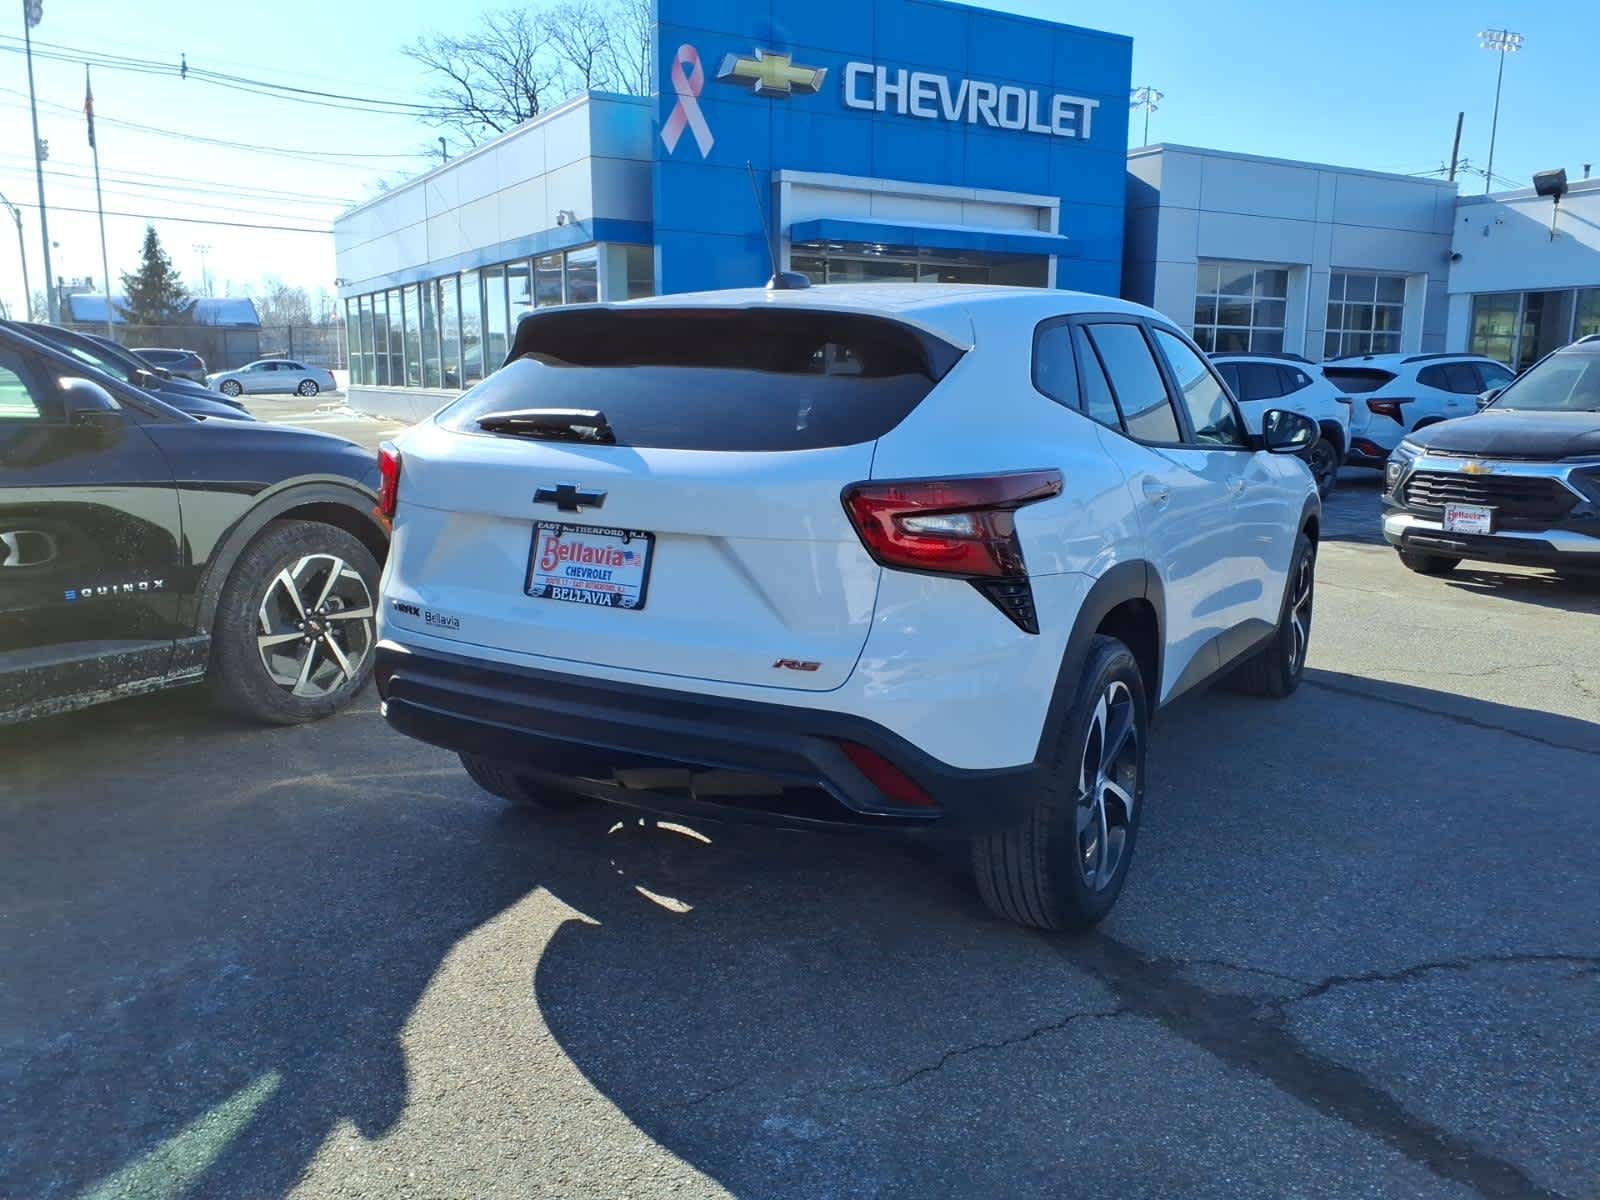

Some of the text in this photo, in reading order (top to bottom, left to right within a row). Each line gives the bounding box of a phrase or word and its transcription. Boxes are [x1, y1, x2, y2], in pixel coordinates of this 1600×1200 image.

[845, 62, 1100, 139] CHEVROLET
[538, 522, 561, 530] EAST
[541, 536, 624, 571] Bellavia
[565, 566, 613, 581] CHEVROLET
[64, 579, 163, 601] EQUINOX
[551, 587, 612, 606] BELLAVIA
[424, 611, 460, 627] Bellavia
[772, 658, 822, 672] RS
